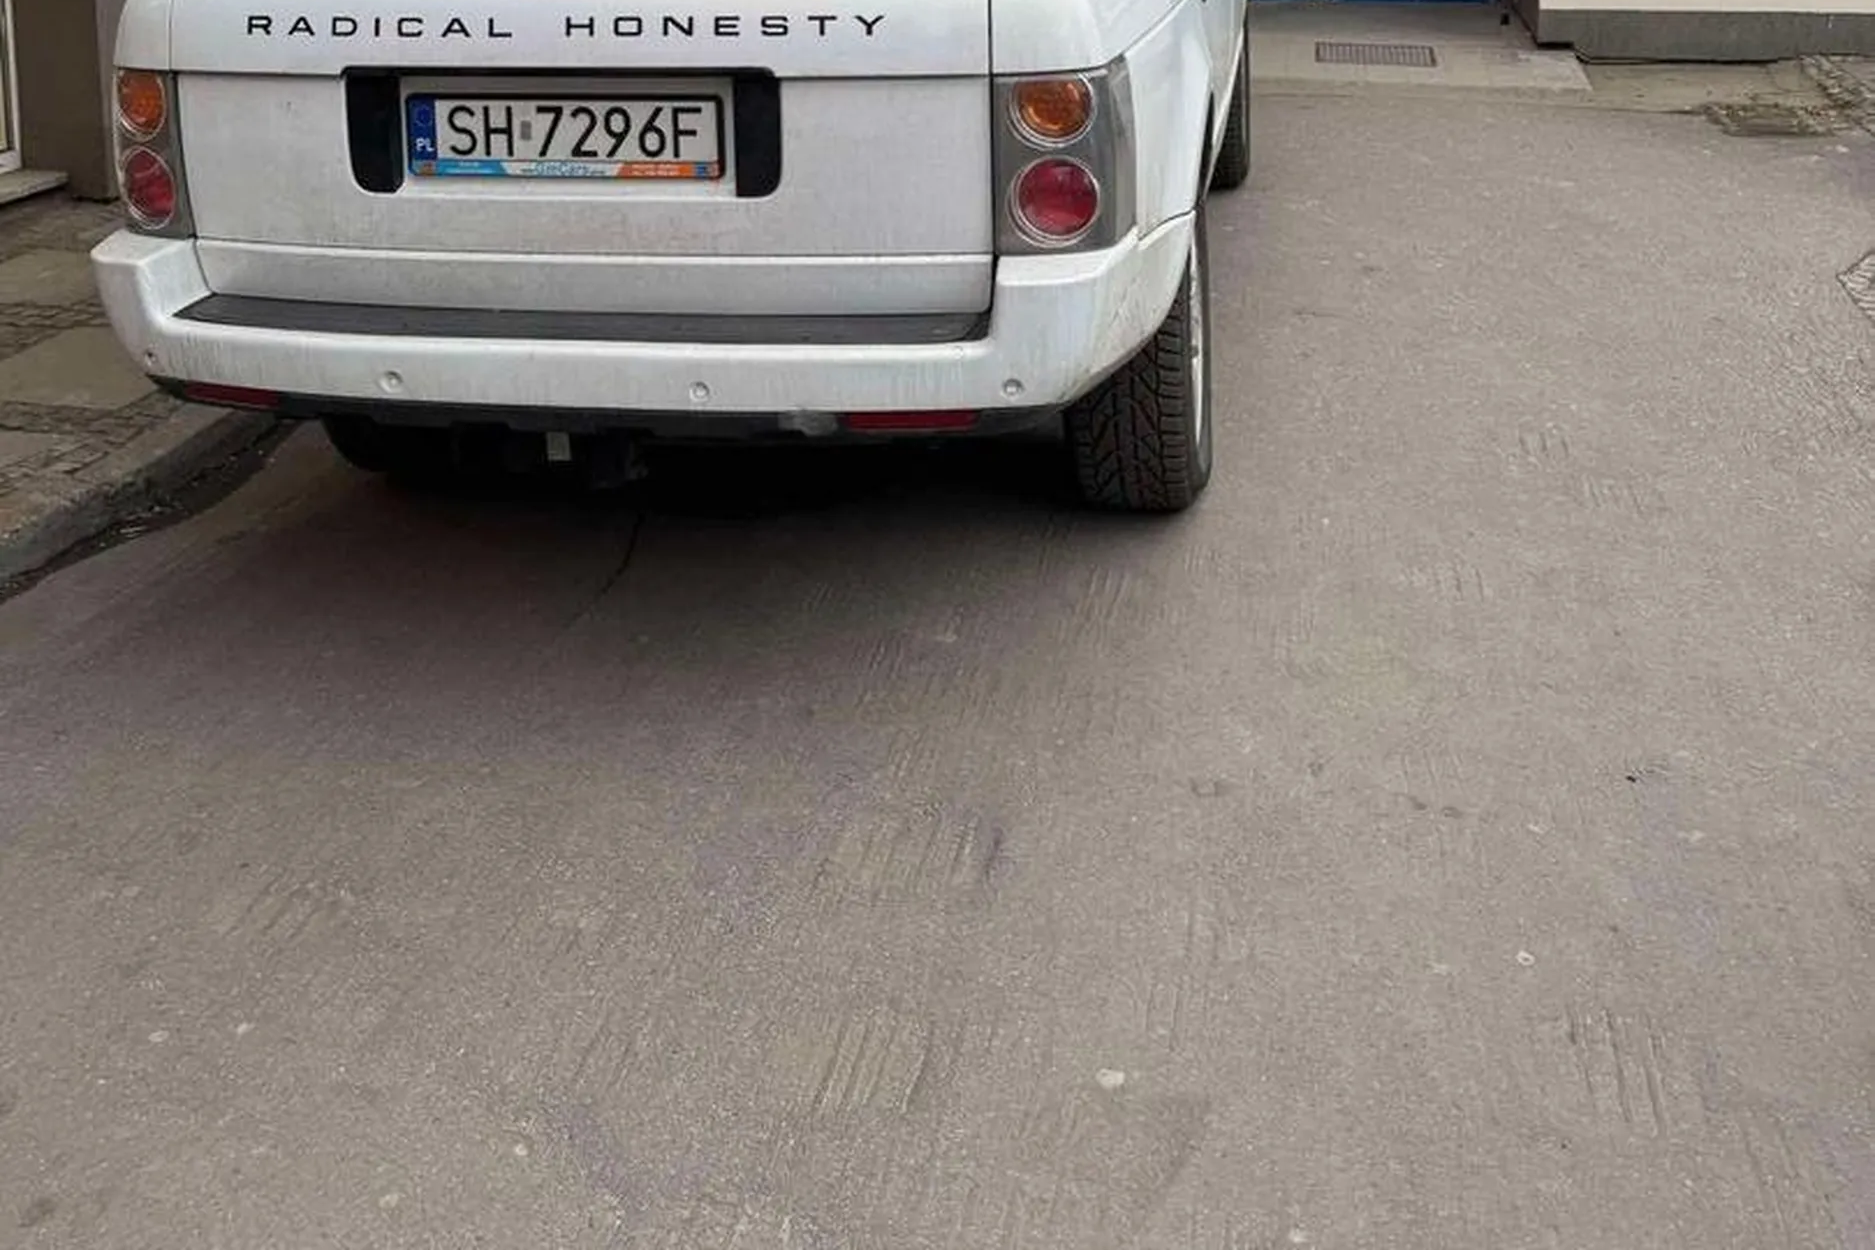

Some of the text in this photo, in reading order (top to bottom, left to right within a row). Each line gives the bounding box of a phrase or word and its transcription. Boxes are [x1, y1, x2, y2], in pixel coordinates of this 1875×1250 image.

[246, 14, 887, 38] RADICAL HONESTY
[446, 105, 703, 159] SH 7296F
[415, 137, 435, 152] PL
